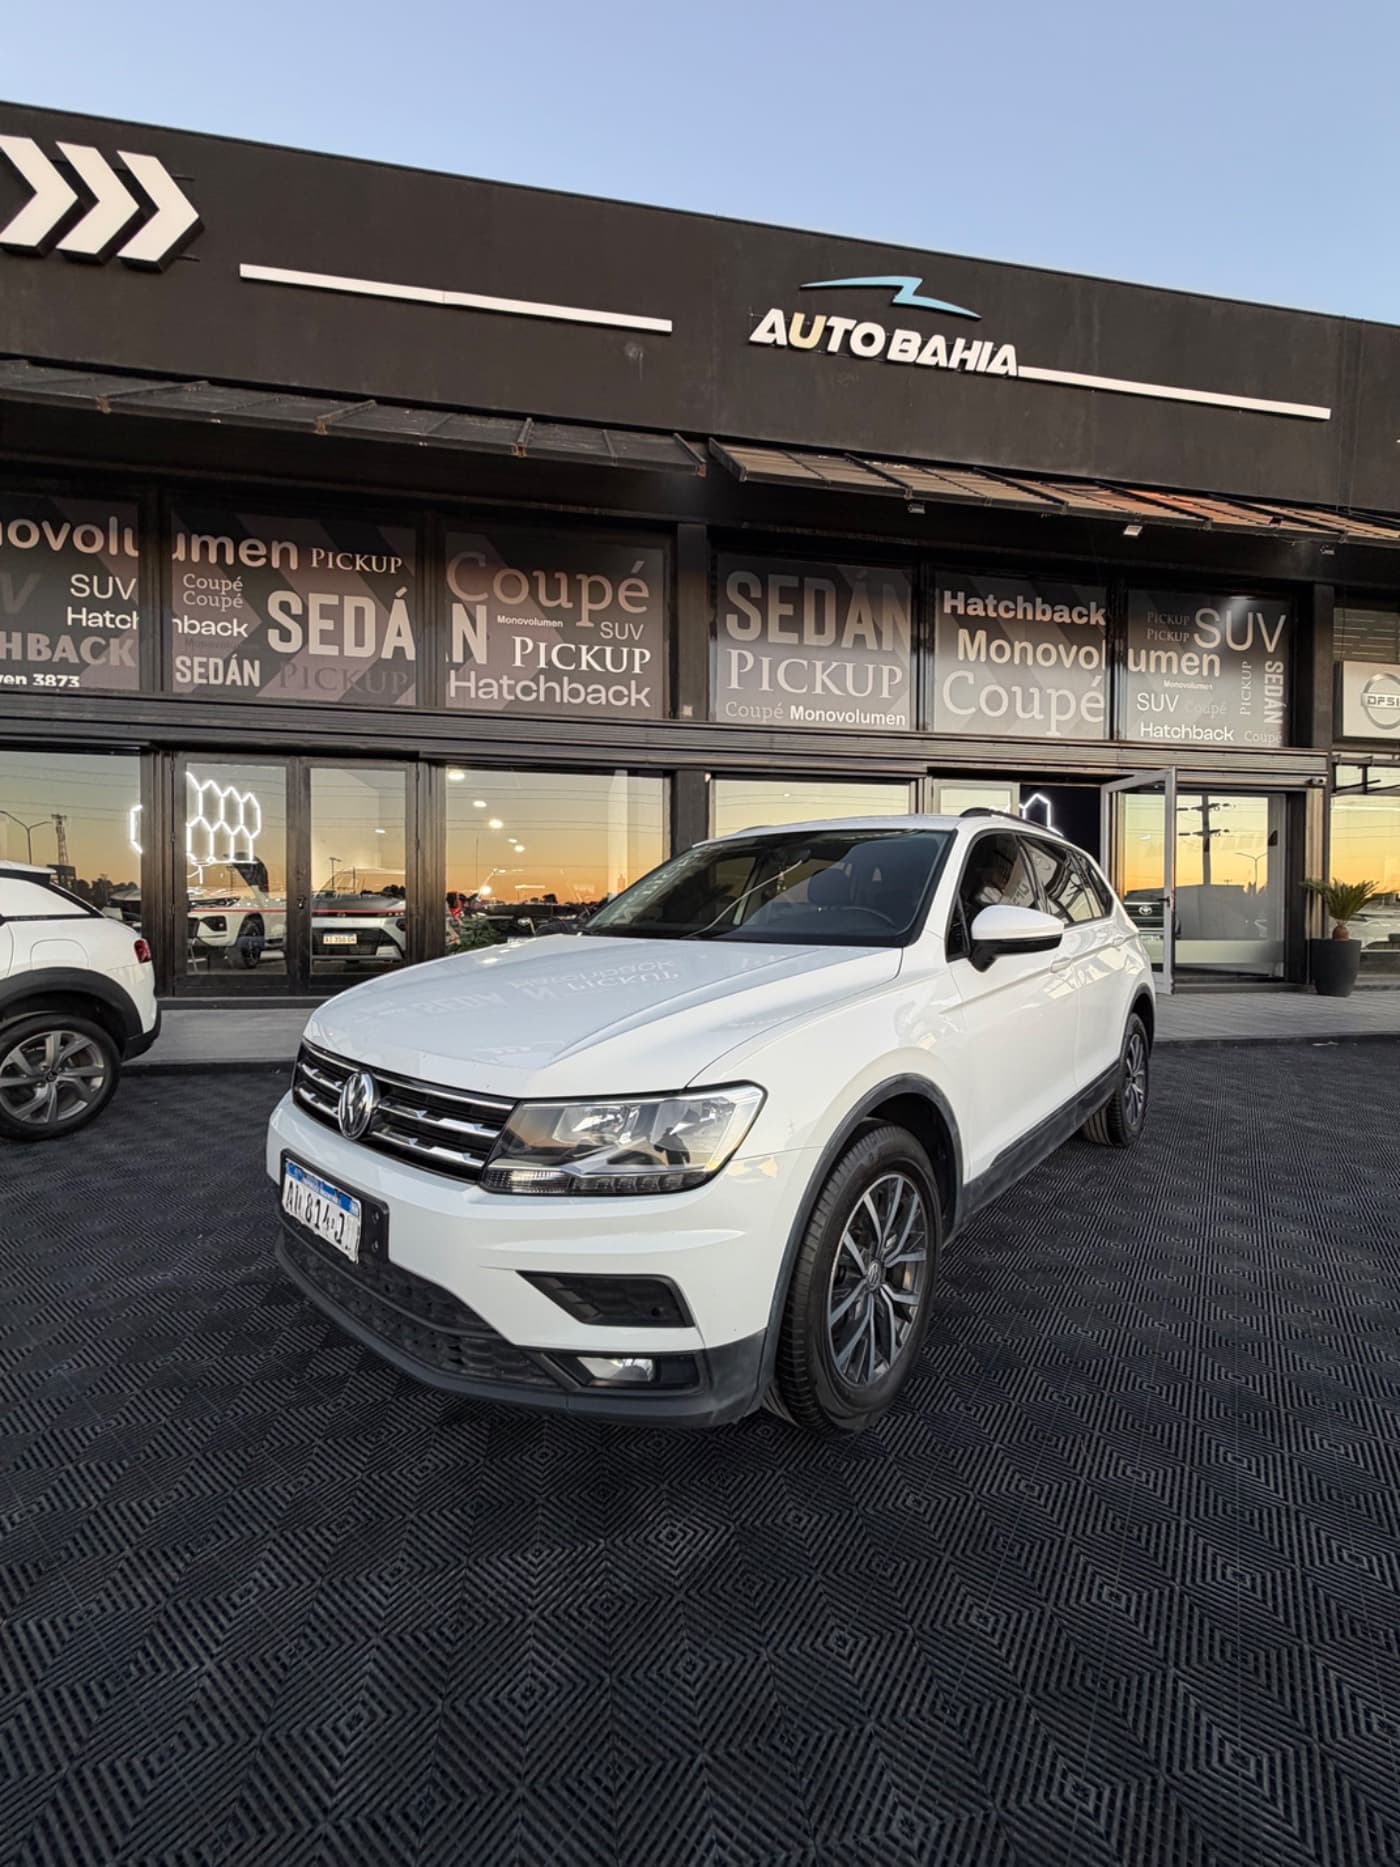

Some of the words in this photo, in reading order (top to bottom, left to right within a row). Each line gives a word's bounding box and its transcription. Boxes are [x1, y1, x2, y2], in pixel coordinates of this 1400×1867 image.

[0, 516, 139, 557] ovolu
[310, 547, 402, 574] PICKUP
[70, 574, 137, 600] SUV
[182, 573, 244, 595] Coupé
[182, 590, 244, 612] Coupé
[446, 551, 650, 628] Coupé
[267, 587, 416, 661] SEDÁ
[497, 615, 563, 628] Monovolumen
[725, 570, 911, 652] SEDÁN
[943, 590, 1106, 625] Hatchback
[452, 603, 487, 664] N
[600, 621, 645, 641] SUV
[1146, 628, 1190, 642] PICKUP
[1193, 607, 1287, 653] SUV
[175, 653, 260, 687] SEDÁN
[512, 636, 651, 675] PICKUP
[1128, 648, 1220, 678] umen
[33, 673, 80, 687] 3873
[279, 660, 409, 697] PICKUP
[450, 669, 650, 707] Hatchback
[727, 649, 902, 699] PICKUP
[1240, 661, 1253, 716] PICKUP
[943, 669, 1105, 737] Coupé
[1136, 691, 1180, 713] SUV
[1264, 660, 1288, 724] SEDÁN
[725, 701, 784, 723] Coupé
[790, 704, 906, 727] Monovolumen
[1140, 721, 1235, 742] Hatchback
